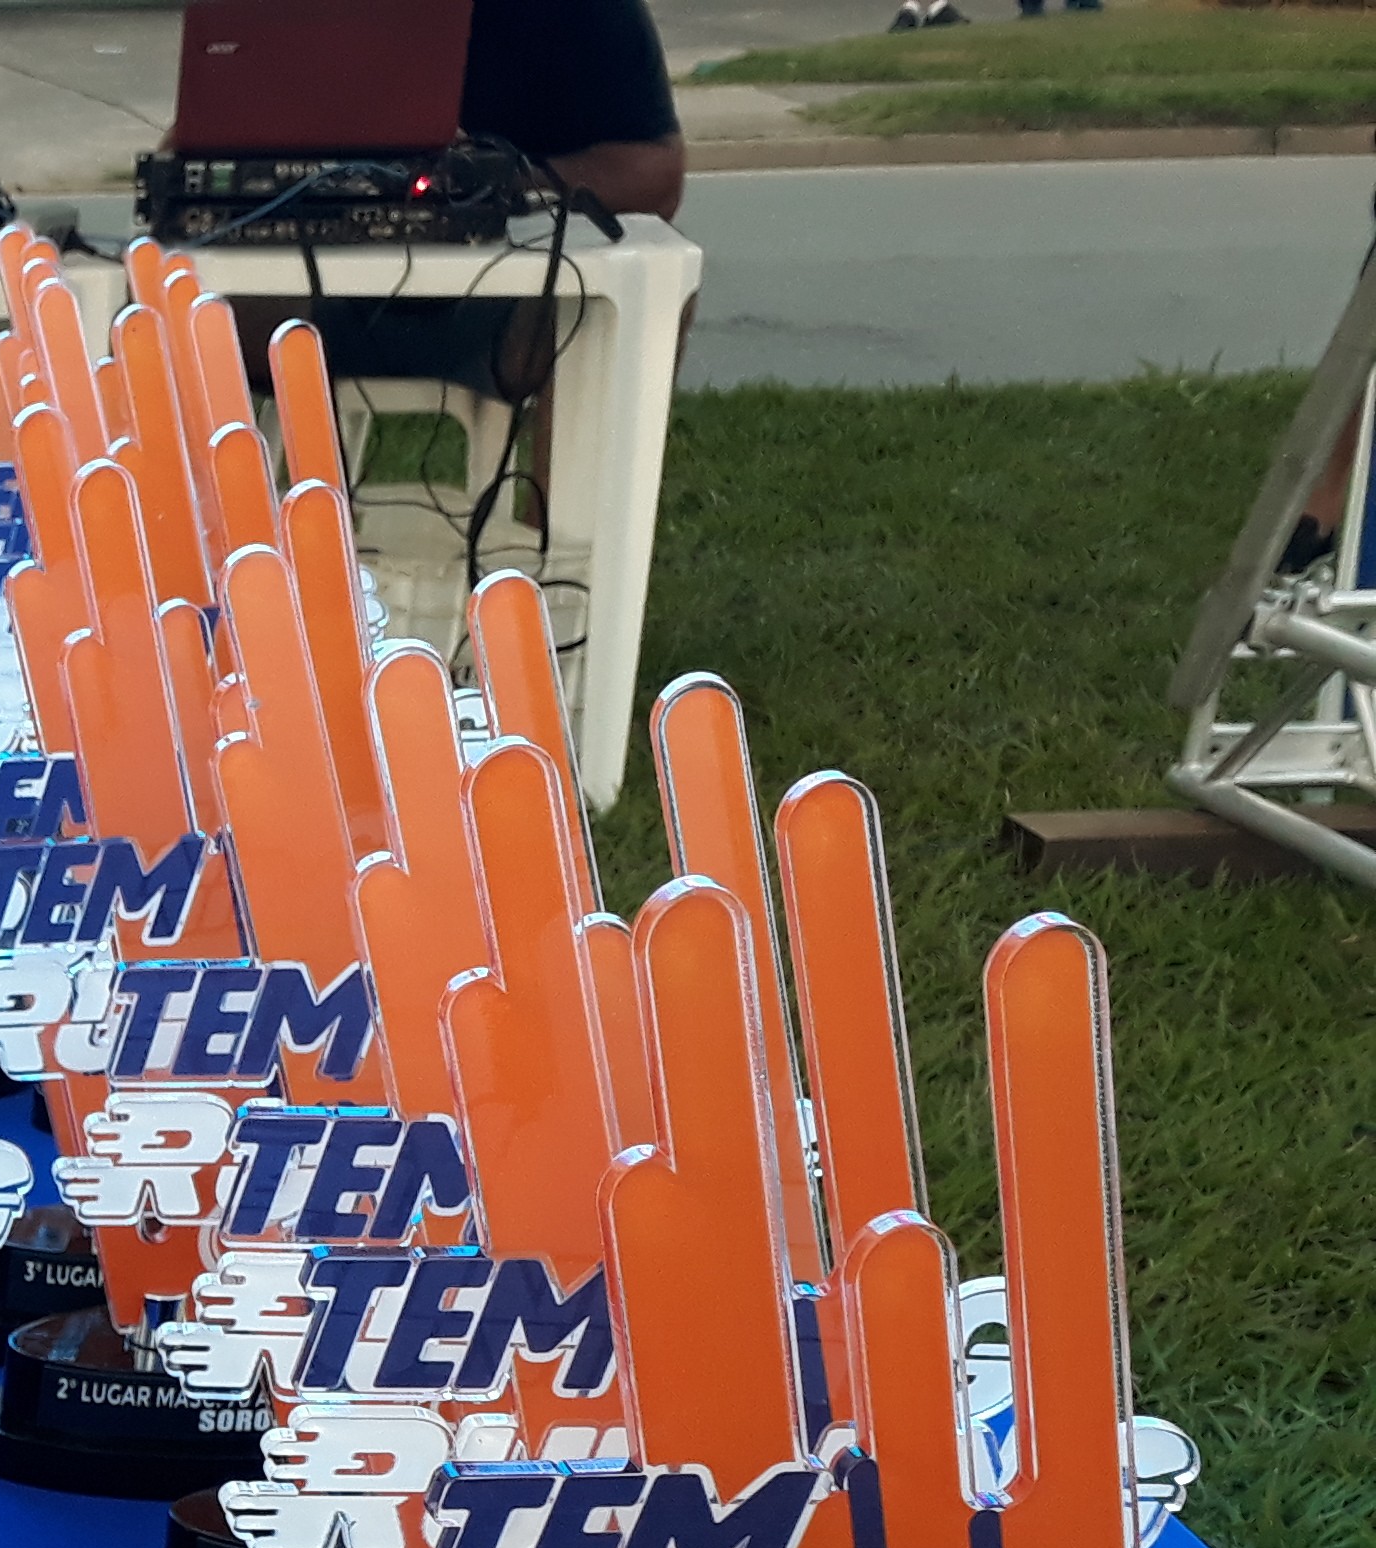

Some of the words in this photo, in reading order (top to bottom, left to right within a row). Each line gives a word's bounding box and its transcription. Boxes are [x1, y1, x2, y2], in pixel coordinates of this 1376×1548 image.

[112, 964, 376, 1082] TEM
[295, 1252, 617, 1395] TEM
[80, 1380, 151, 1408] LUGAR
